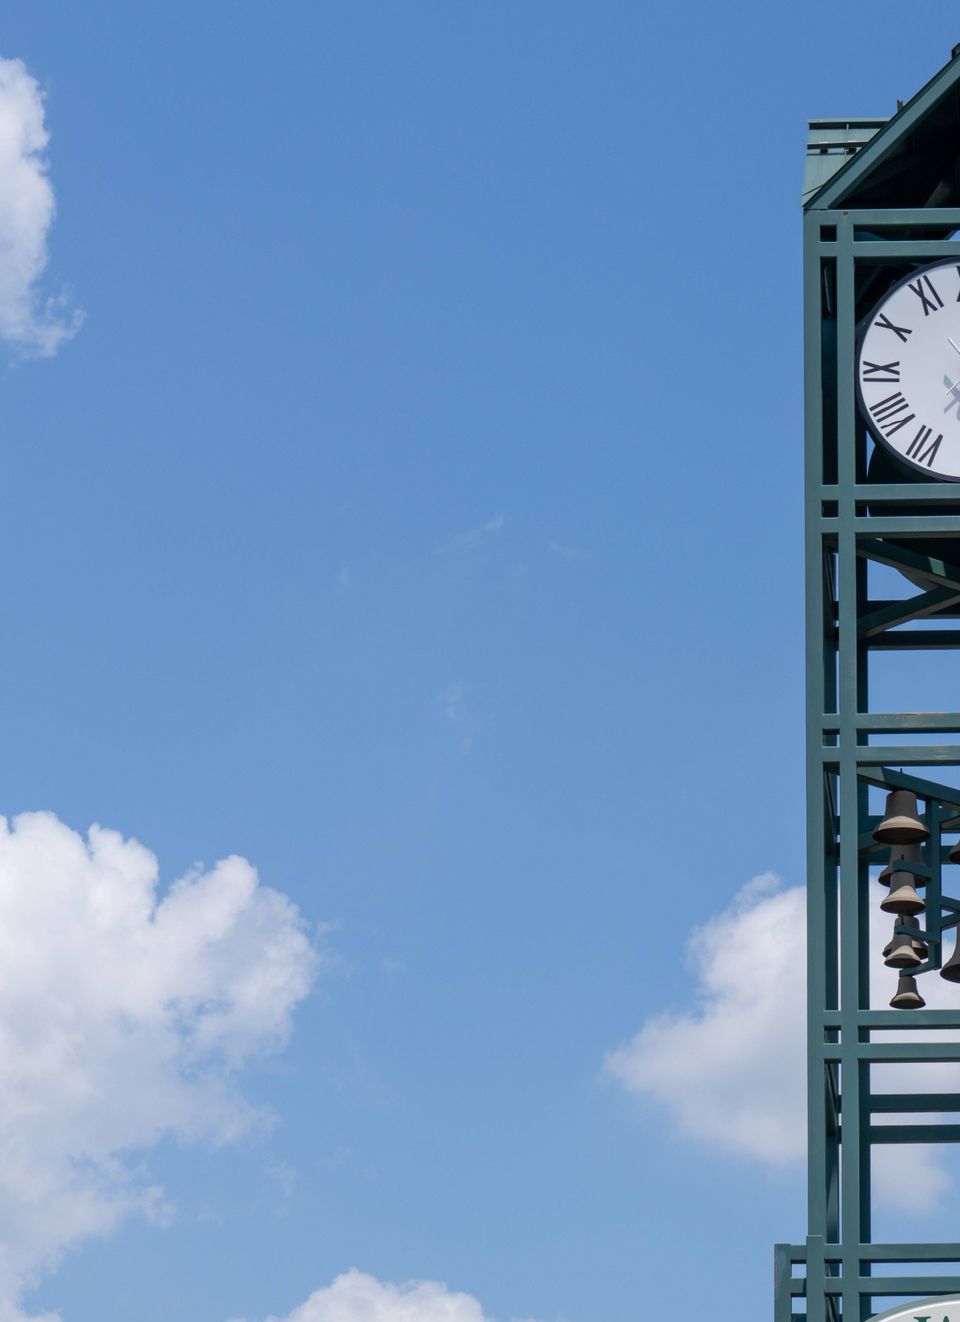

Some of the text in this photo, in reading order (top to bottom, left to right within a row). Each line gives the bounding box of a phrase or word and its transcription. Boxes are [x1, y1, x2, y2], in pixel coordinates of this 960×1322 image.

[908, 275, 944, 316] XI
[874, 313, 912, 343] X
[863, 360, 900, 382] IX
[869, 391, 915, 438] VIII
[905, 424, 943, 467] VII
